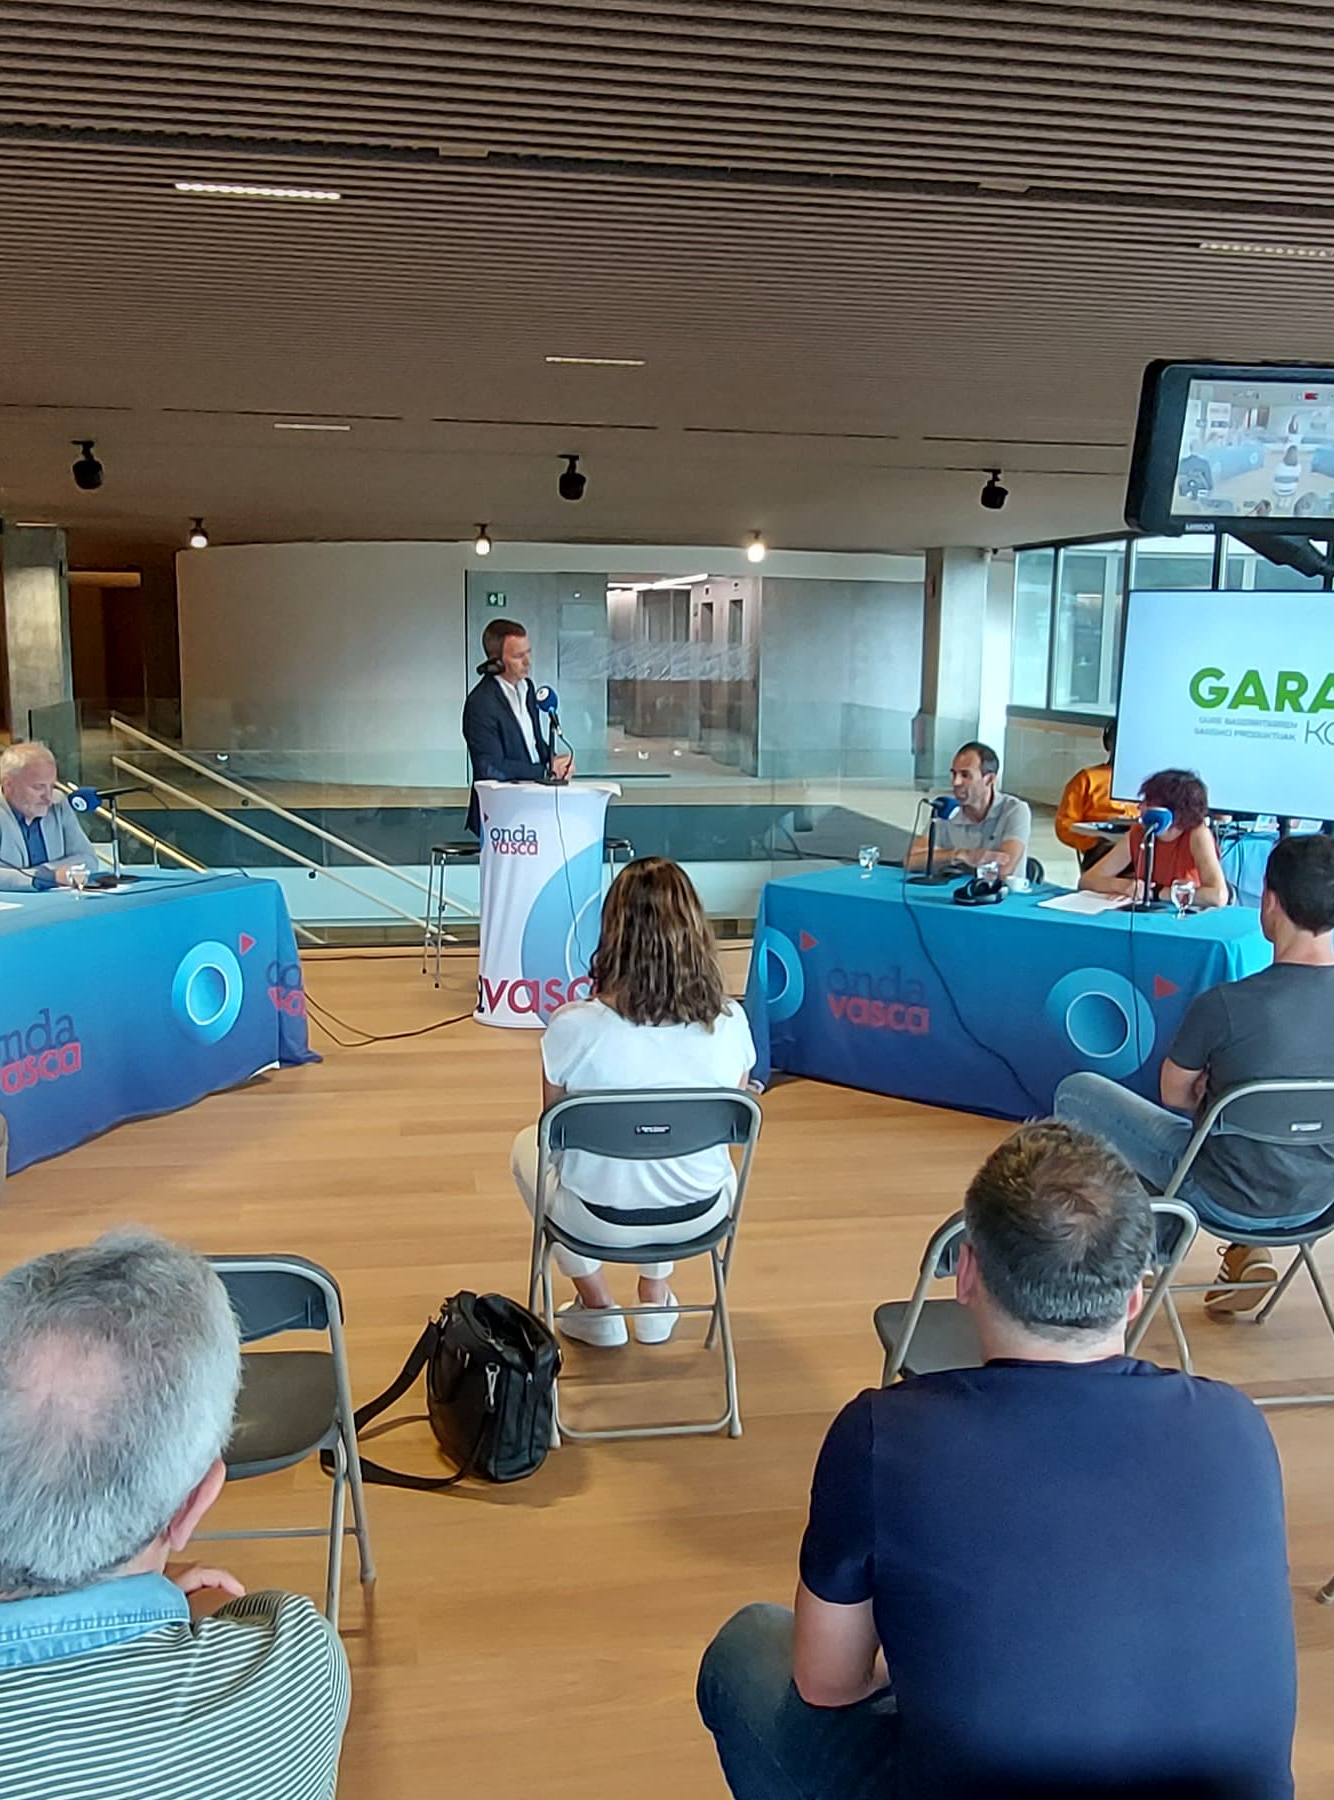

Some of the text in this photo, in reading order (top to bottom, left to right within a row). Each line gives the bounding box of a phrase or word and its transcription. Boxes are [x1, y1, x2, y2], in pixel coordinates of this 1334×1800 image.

[490, 824, 538, 842] onda
[491, 840, 539, 855] vasca
[482, 976, 594, 1015] vasc
[827, 964, 925, 1003] onda
[827, 993, 931, 1035] vasca
